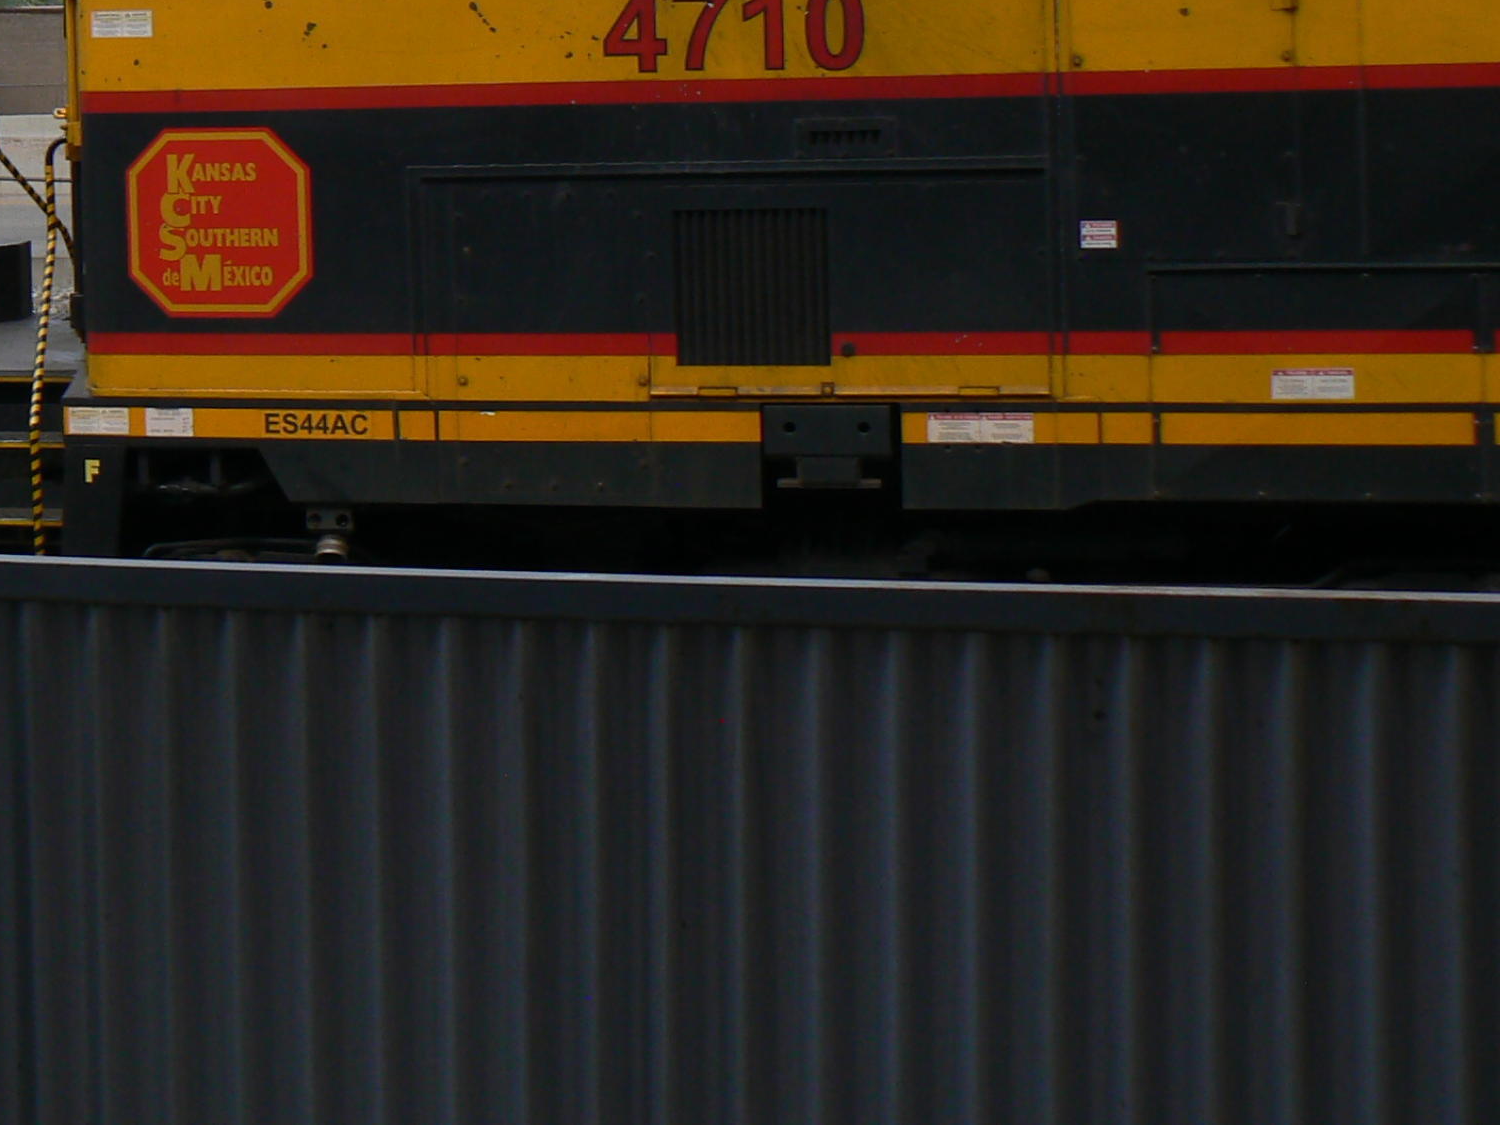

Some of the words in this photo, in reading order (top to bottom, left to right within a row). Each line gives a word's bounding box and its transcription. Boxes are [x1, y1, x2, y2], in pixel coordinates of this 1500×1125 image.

[166, 154, 258, 193] KANSAS
[160, 193, 223, 227] CITY
[159, 223, 280, 261] SOUTHERN
[264, 413, 368, 435] ES44AC
[85, 459, 100, 483] F
